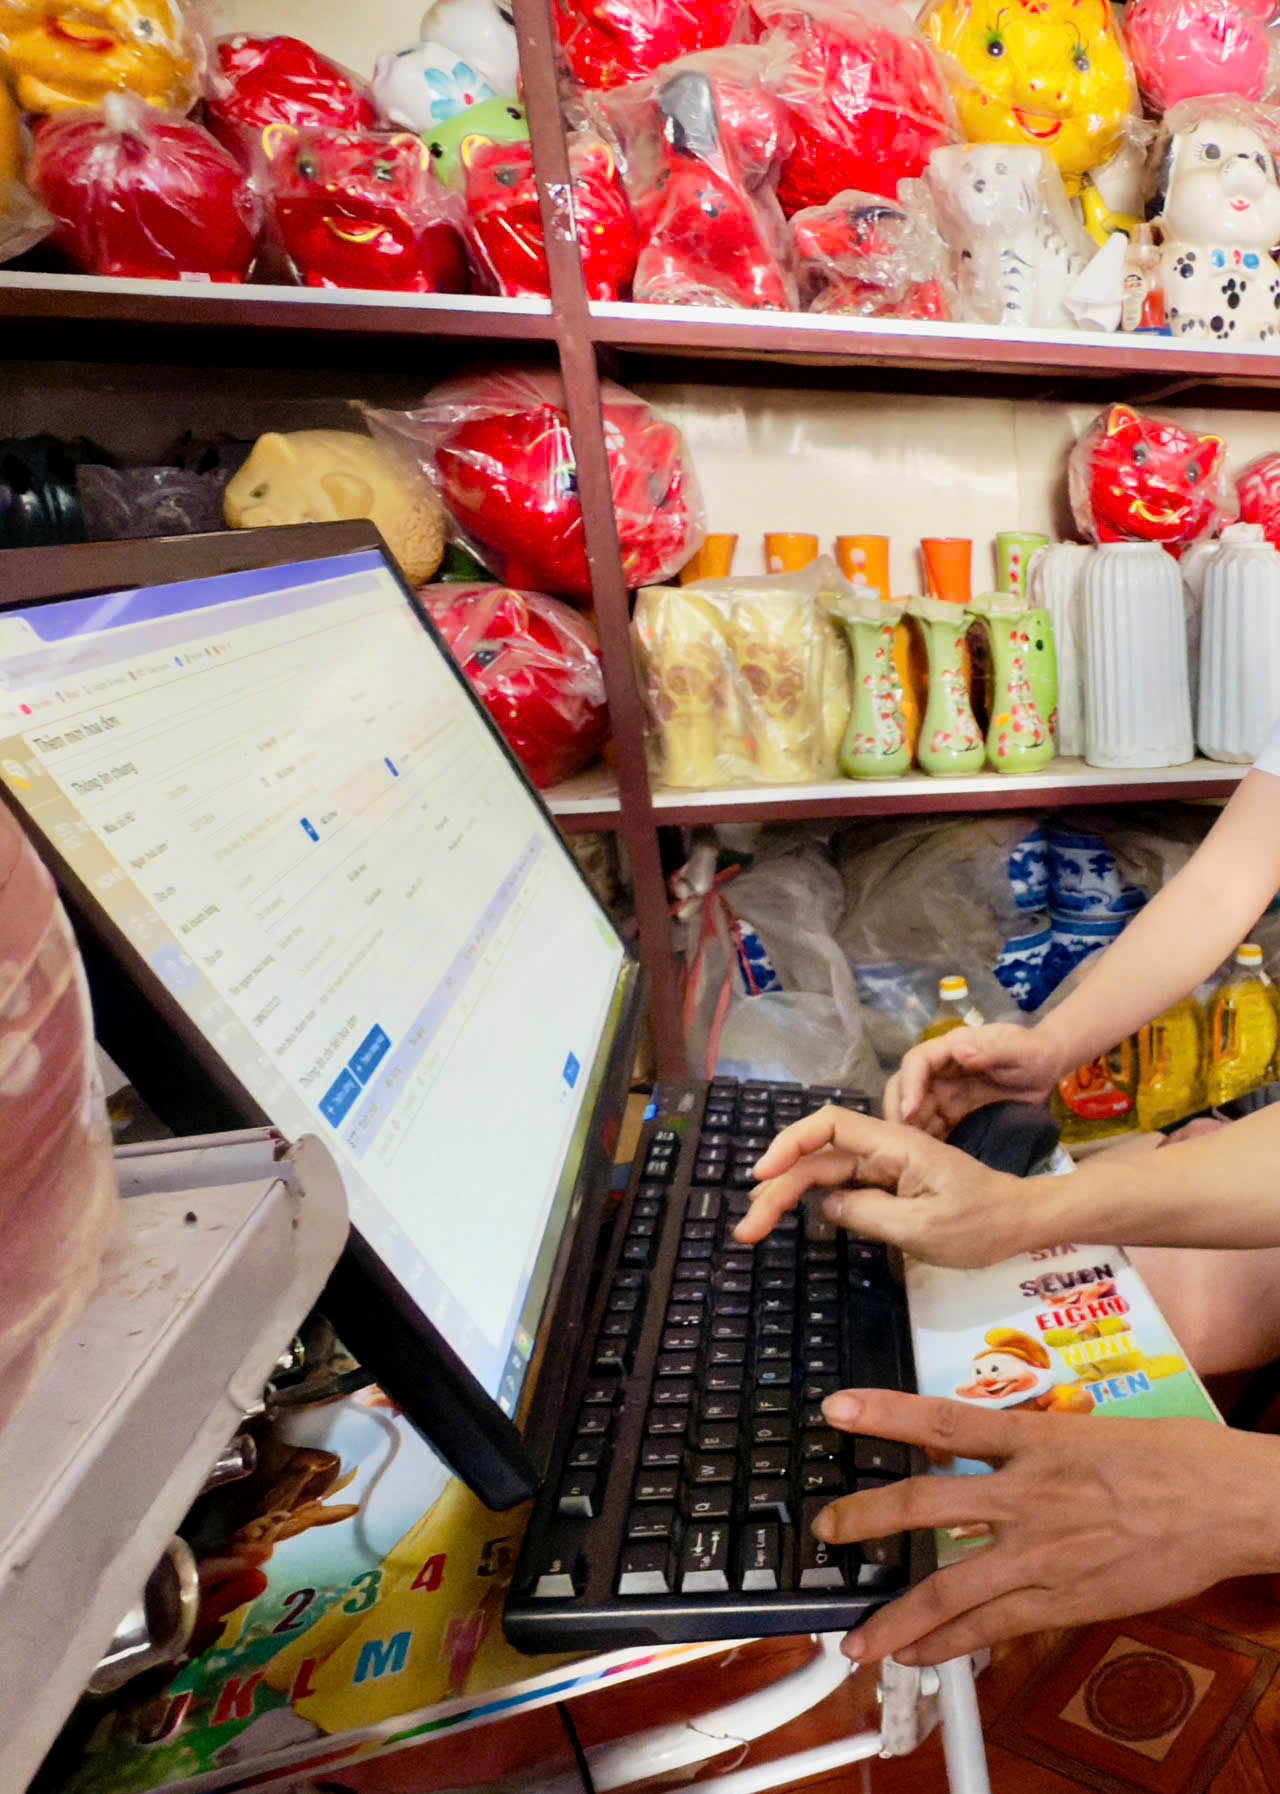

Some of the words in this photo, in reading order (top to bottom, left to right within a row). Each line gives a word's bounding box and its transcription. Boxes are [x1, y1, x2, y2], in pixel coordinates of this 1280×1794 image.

[1019, 1264, 1114, 1297] SEVEN
[1036, 1296, 1131, 1331] EIGHT
[1085, 1371, 1151, 1404] TEN
[273, 1588, 316, 1635] 2
[343, 1571, 383, 1614] 3
[410, 1553, 447, 1592] 4
[211, 1672, 263, 1726] K
[289, 1657, 320, 1703] L
[353, 1631, 413, 1685] M
